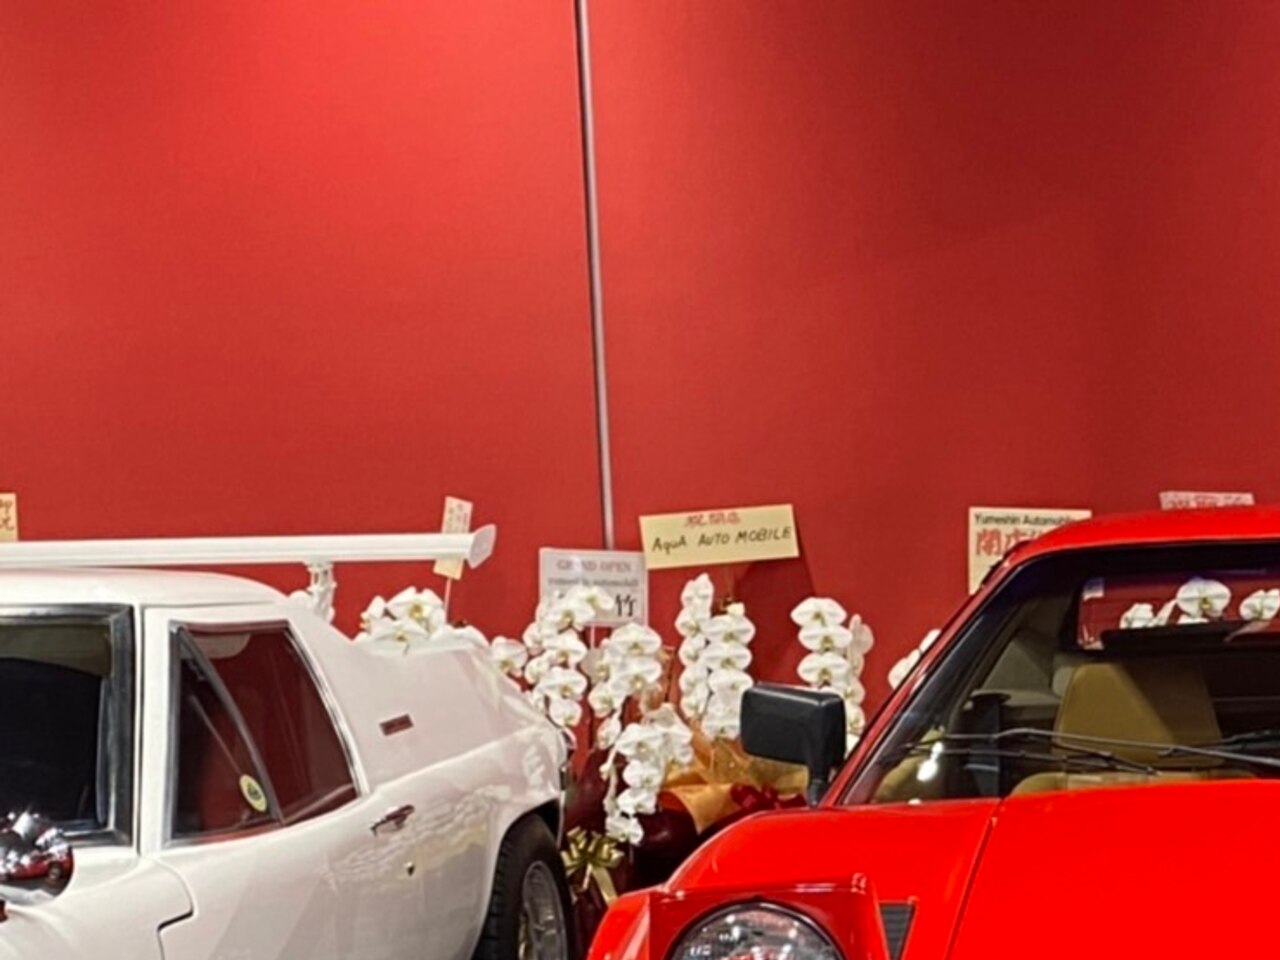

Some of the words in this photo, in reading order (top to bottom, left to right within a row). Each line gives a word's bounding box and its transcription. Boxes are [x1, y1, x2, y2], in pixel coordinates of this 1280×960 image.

[974, 513, 1021, 525] Yumeshin
[735, 525, 792, 543] MOBILE
[556, 560, 597, 572] GRND
[600, 560, 632, 573] OPEN
